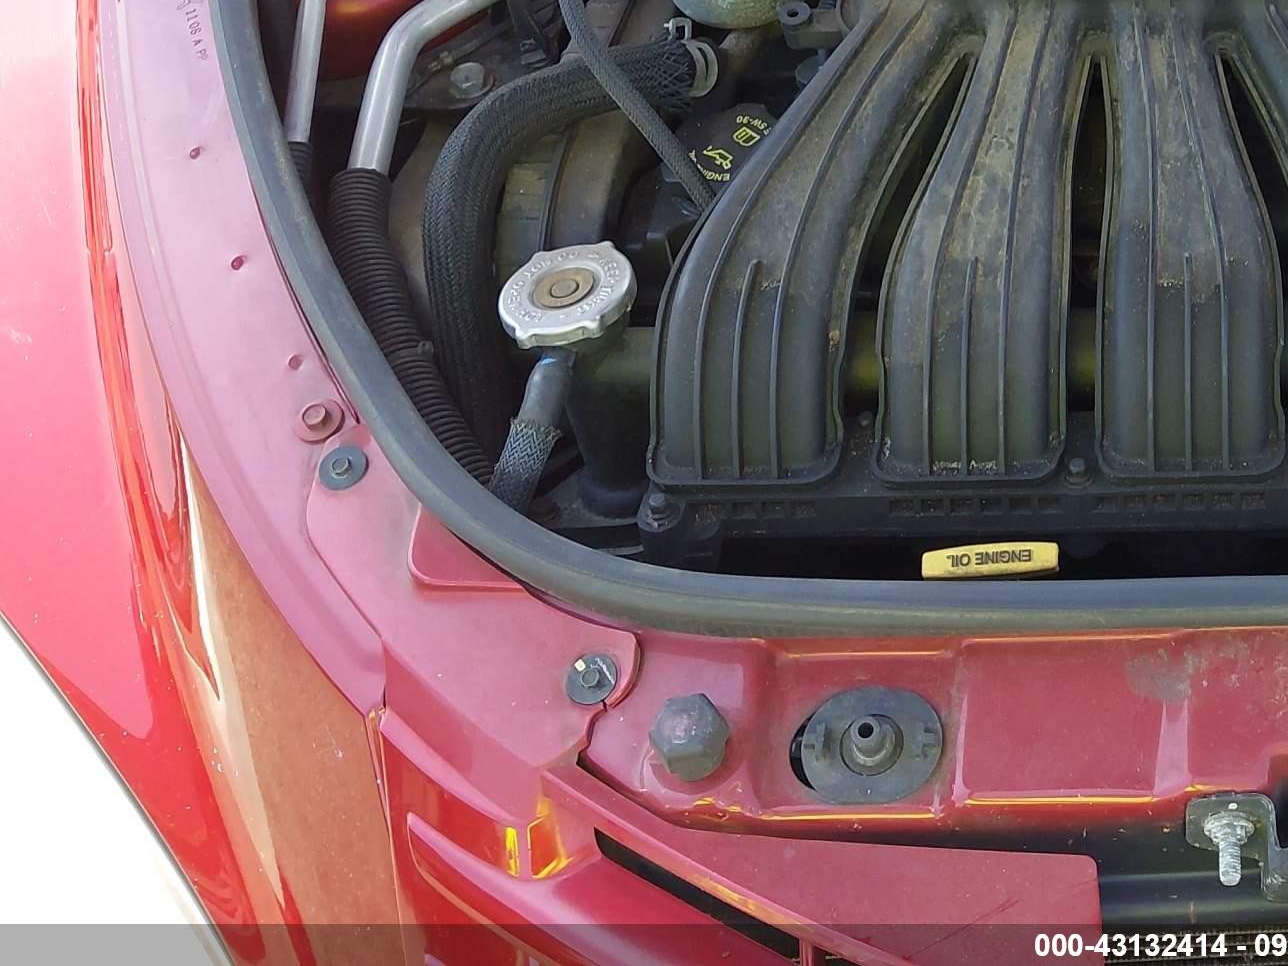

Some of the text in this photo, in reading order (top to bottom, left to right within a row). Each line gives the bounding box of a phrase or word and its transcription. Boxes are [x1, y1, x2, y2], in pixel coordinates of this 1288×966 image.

[736, 115, 768, 130] 5W-30
[946, 550, 1032, 567] ENGINE OIL
